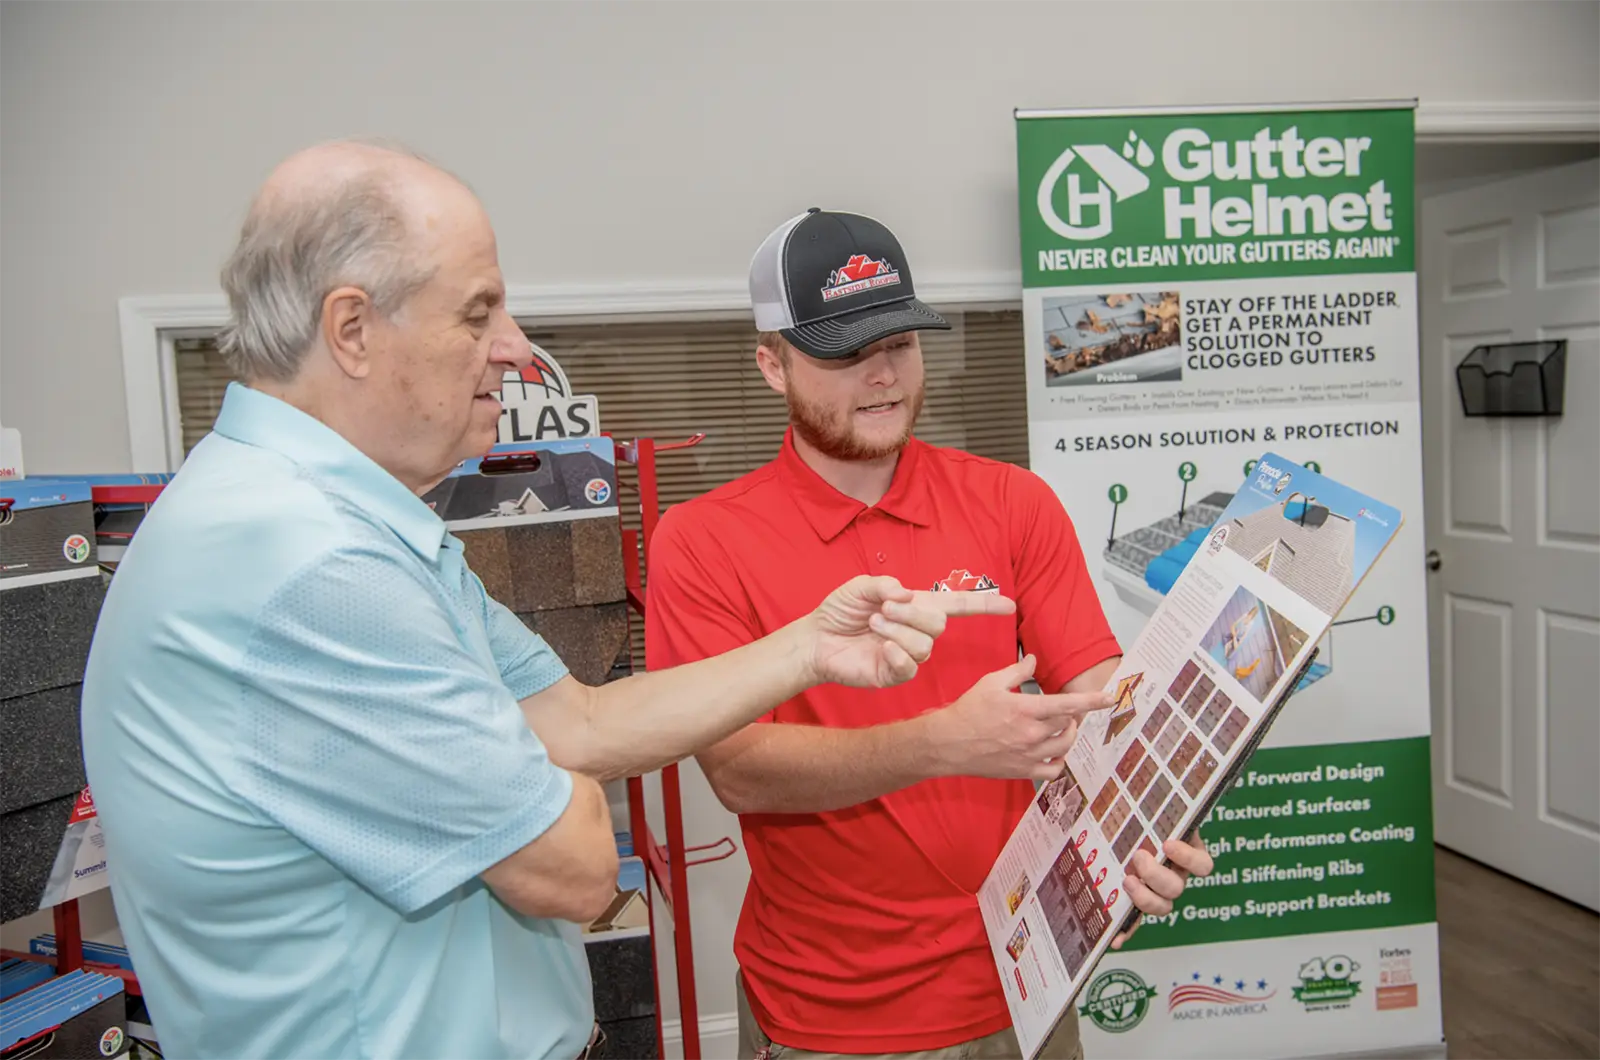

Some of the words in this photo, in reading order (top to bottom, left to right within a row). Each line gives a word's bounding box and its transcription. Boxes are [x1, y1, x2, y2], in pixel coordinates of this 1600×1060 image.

[1162, 125, 1371, 181] Gutter
[1163, 180, 1393, 239] Helmet
[1038, 248, 1108, 271] NEVER
[1111, 244, 1178, 268] CLEAN
[1181, 242, 1236, 265] YOUR
[1240, 239, 1331, 263] GUTTERS
[1186, 299, 1233, 315] STAY
[1239, 296, 1277, 313] OFF
[1282, 295, 1317, 311] THE
[1186, 317, 1222, 333] GET
[1228, 316, 1242, 331] A
[1249, 311, 1373, 330] PERMANENT
[1187, 332, 1291, 352] SOLUTION
[1296, 331, 1323, 347] TO
[1188, 351, 1283, 370] CLOGGED
[1290, 347, 1377, 366] GUTTERS
[1097, 373, 1138, 383] Problem
[500, 402, 590, 442] LAS
[1055, 438, 1067, 453] 4
[1074, 433, 1152, 452] SEASON
[1160, 428, 1256, 447] SOLUTION
[1263, 425, 1277, 441] &
[1284, 420, 1400, 439] PROTECTION
[1183, 465, 1192, 479] 2
[1114, 487, 1121, 501] 1
[1247, 766, 1322, 786] Forward
[1325, 763, 1384, 782] Design
[1216, 800, 1293, 820] Textured
[1296, 797, 1371, 815] Surfaces
[1204, 837, 1231, 858] igh
[1235, 829, 1346, 852] Performance
[1349, 825, 1415, 845] Coating
[1242, 862, 1325, 883] Stiffening
[1328, 860, 1364, 877] Ribs
[1139, 908, 1179, 927] eavy
[1182, 903, 1242, 922] Gauge
[1245, 896, 1314, 917] Support
[1317, 890, 1391, 909] Brackets
[1379, 948, 1412, 959] Forbes
[1299, 955, 1353, 981] 40
[1173, 1009, 1204, 1021] MADE
[1207, 1008, 1220, 1019] IN
[1221, 1004, 1268, 1018] AMERICA
